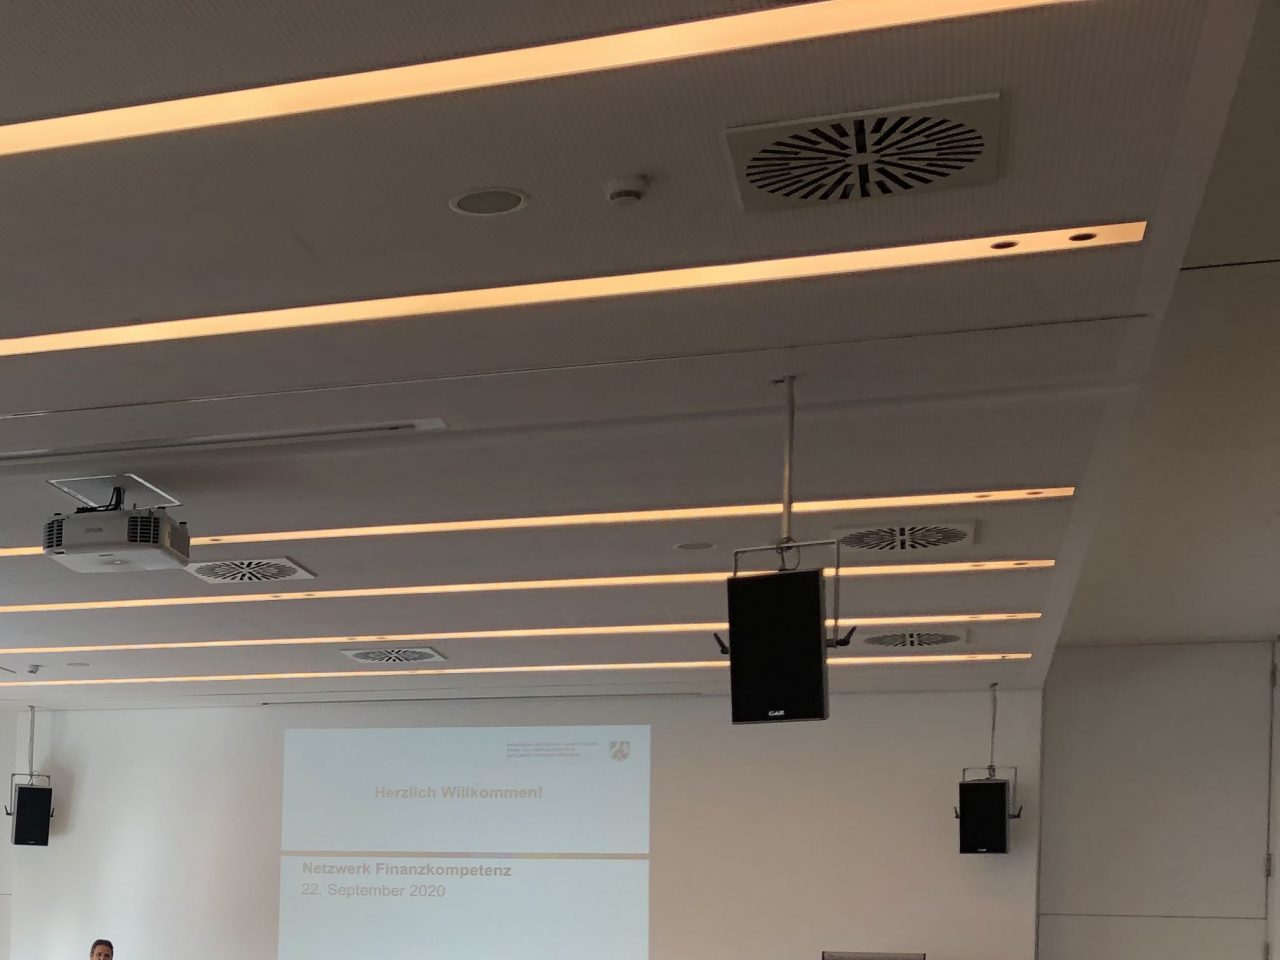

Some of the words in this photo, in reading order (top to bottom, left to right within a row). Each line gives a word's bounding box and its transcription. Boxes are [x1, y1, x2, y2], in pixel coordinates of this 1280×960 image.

[374, 785, 437, 799] Herzlich
[440, 785, 544, 800] Willkommen!
[301, 861, 371, 876] Netzwerk
[375, 862, 512, 878] Finanzkompetenz
[301, 883, 322, 896] 22.
[327, 884, 406, 899] September
[409, 884, 446, 898] 2020
